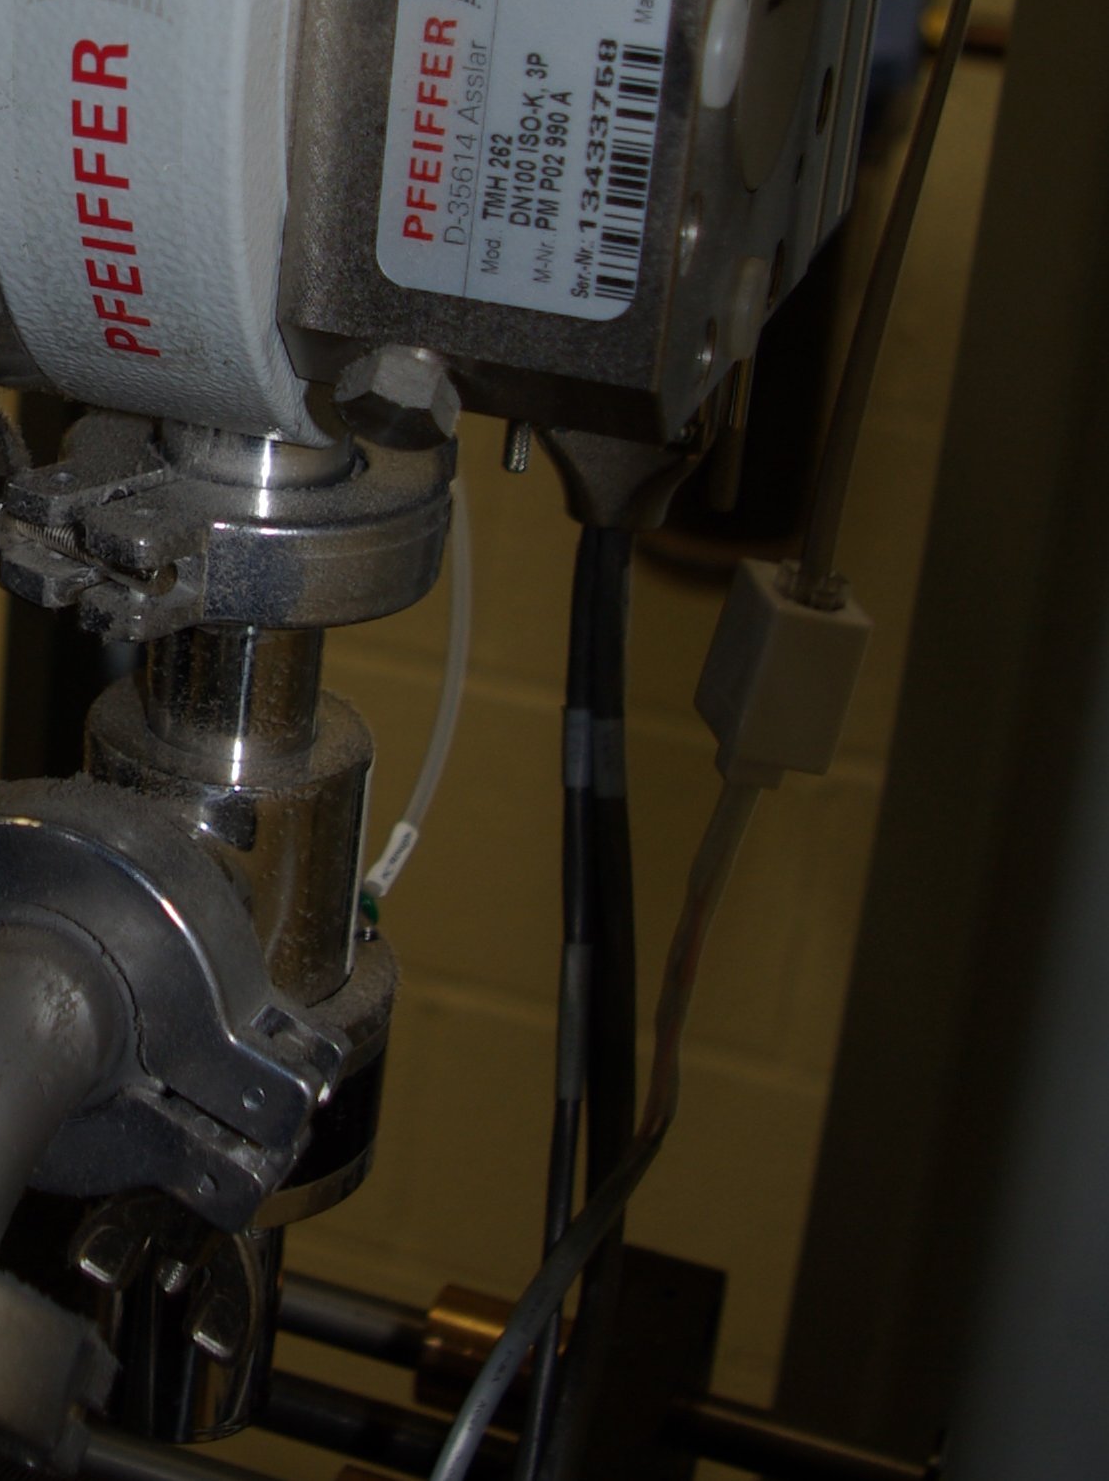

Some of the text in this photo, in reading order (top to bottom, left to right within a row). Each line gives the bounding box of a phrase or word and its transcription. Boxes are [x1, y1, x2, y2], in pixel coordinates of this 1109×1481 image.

[550, 91, 572, 106] A
[403, 16, 457, 242] PFEIFFER
[443, 40, 488, 246] D-35614 Asslar
[489, 133, 512, 168] 262
[509, 160, 536, 227] DN100
[526, 52, 548, 80] 3P
[545, 111, 569, 147] 990
[579, 38, 618, 231] 13433758
[540, 153, 565, 193] P02
[71, 37, 161, 358] PFEIFFER
[482, 176, 509, 221] TMH
[534, 199, 560, 231] PM
